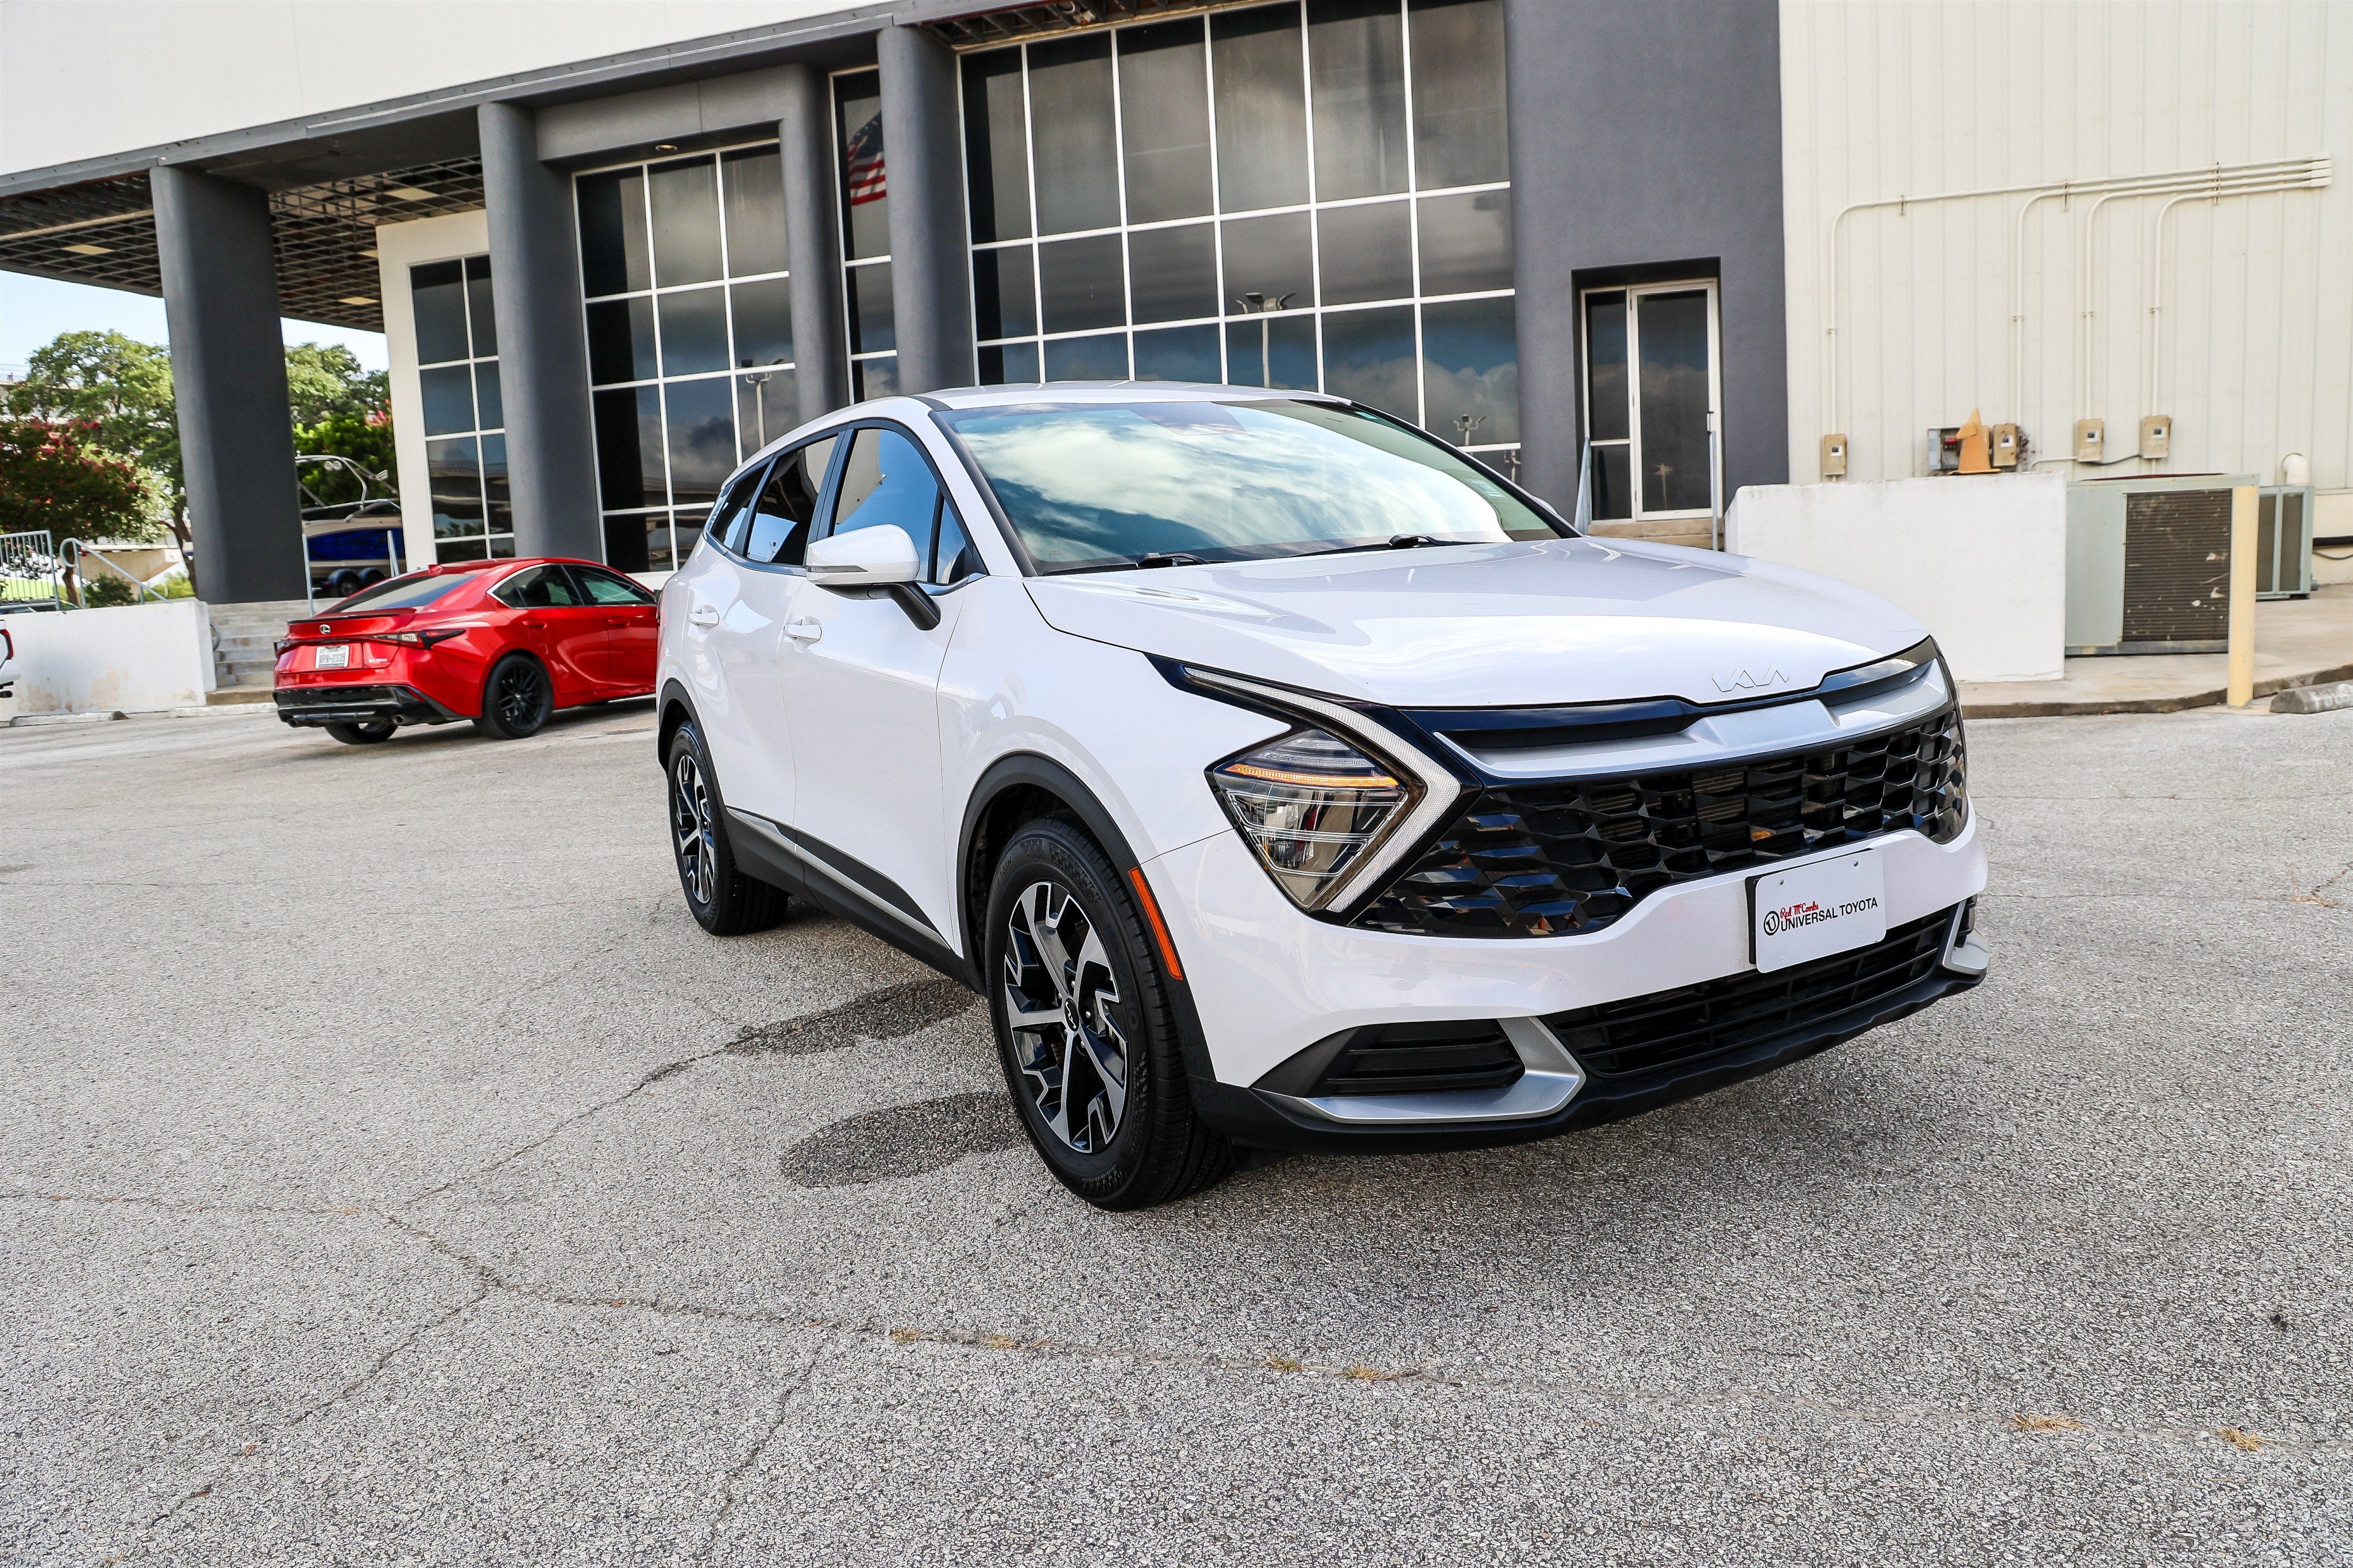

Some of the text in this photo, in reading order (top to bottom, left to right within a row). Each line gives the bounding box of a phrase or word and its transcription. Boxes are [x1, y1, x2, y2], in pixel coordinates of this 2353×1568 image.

[1780, 907, 1792, 921] Red
[1781, 897, 1878, 932] UNIVERSAL TOYOTA
